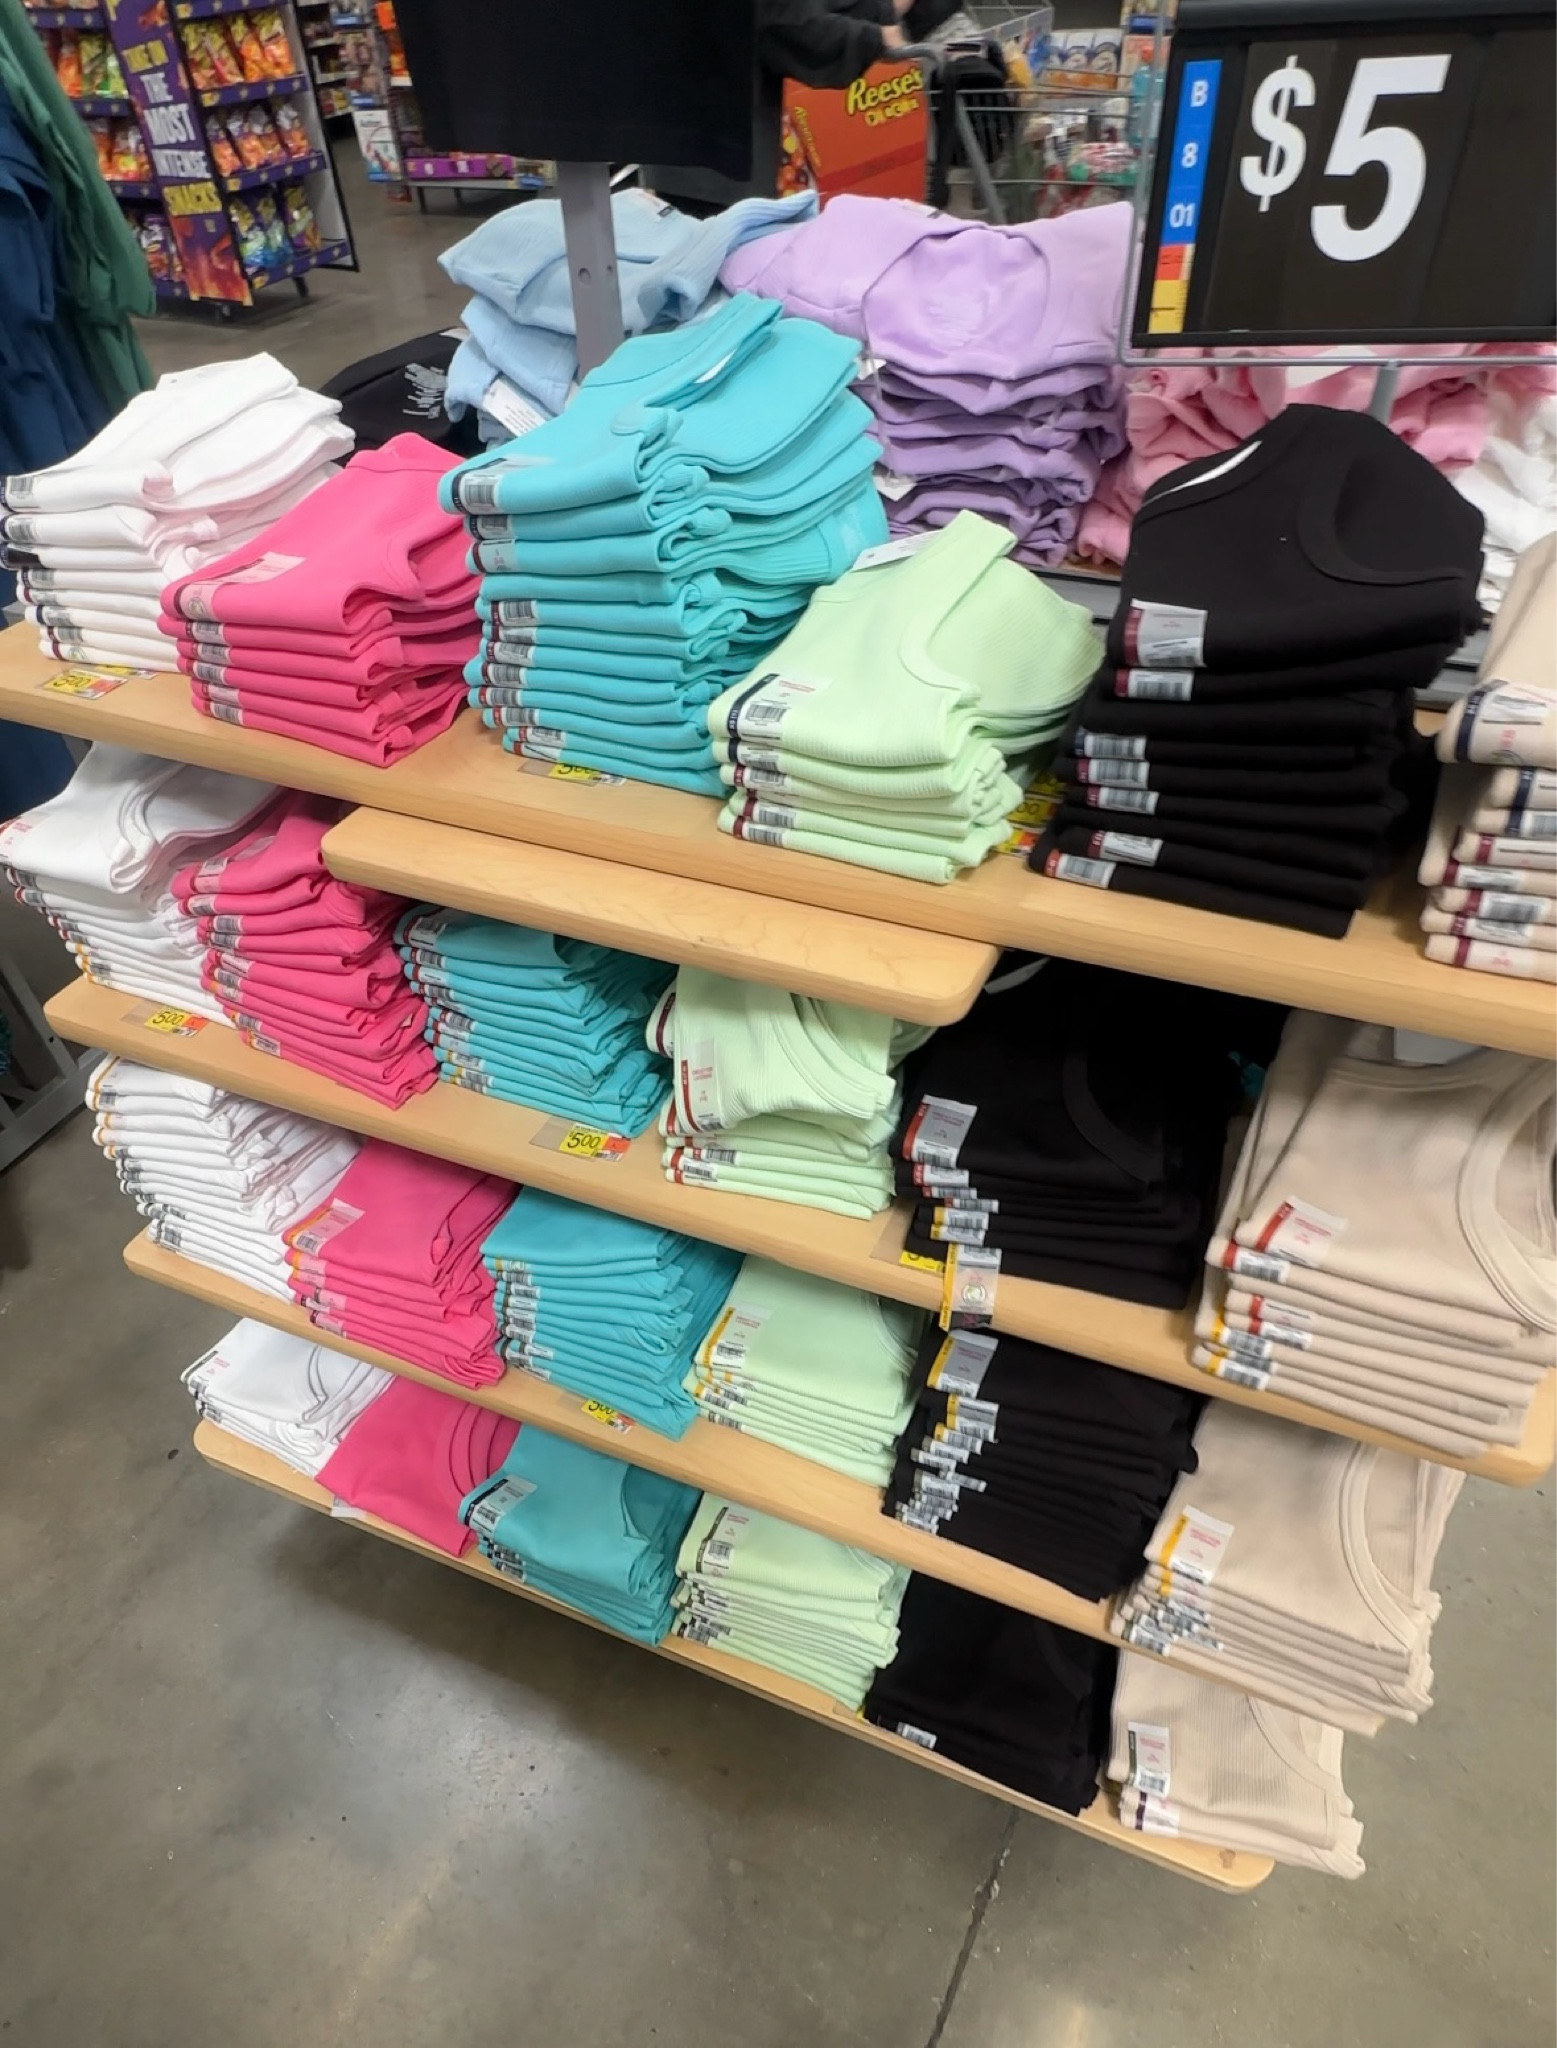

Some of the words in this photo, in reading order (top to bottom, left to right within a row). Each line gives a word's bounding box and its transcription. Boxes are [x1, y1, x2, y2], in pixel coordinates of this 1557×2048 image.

[140, 72, 173, 104] THE
[846, 68, 924, 116] Reese's
[1190, 80, 1209, 108] B
[144, 103, 196, 145] MOST
[152, 149, 212, 179] INTENSE
[1181, 142, 1199, 168] 8
[1240, 54, 1452, 262] $5
[163, 182, 223, 215] SNACKS
[1170, 203, 1195, 227] 01
